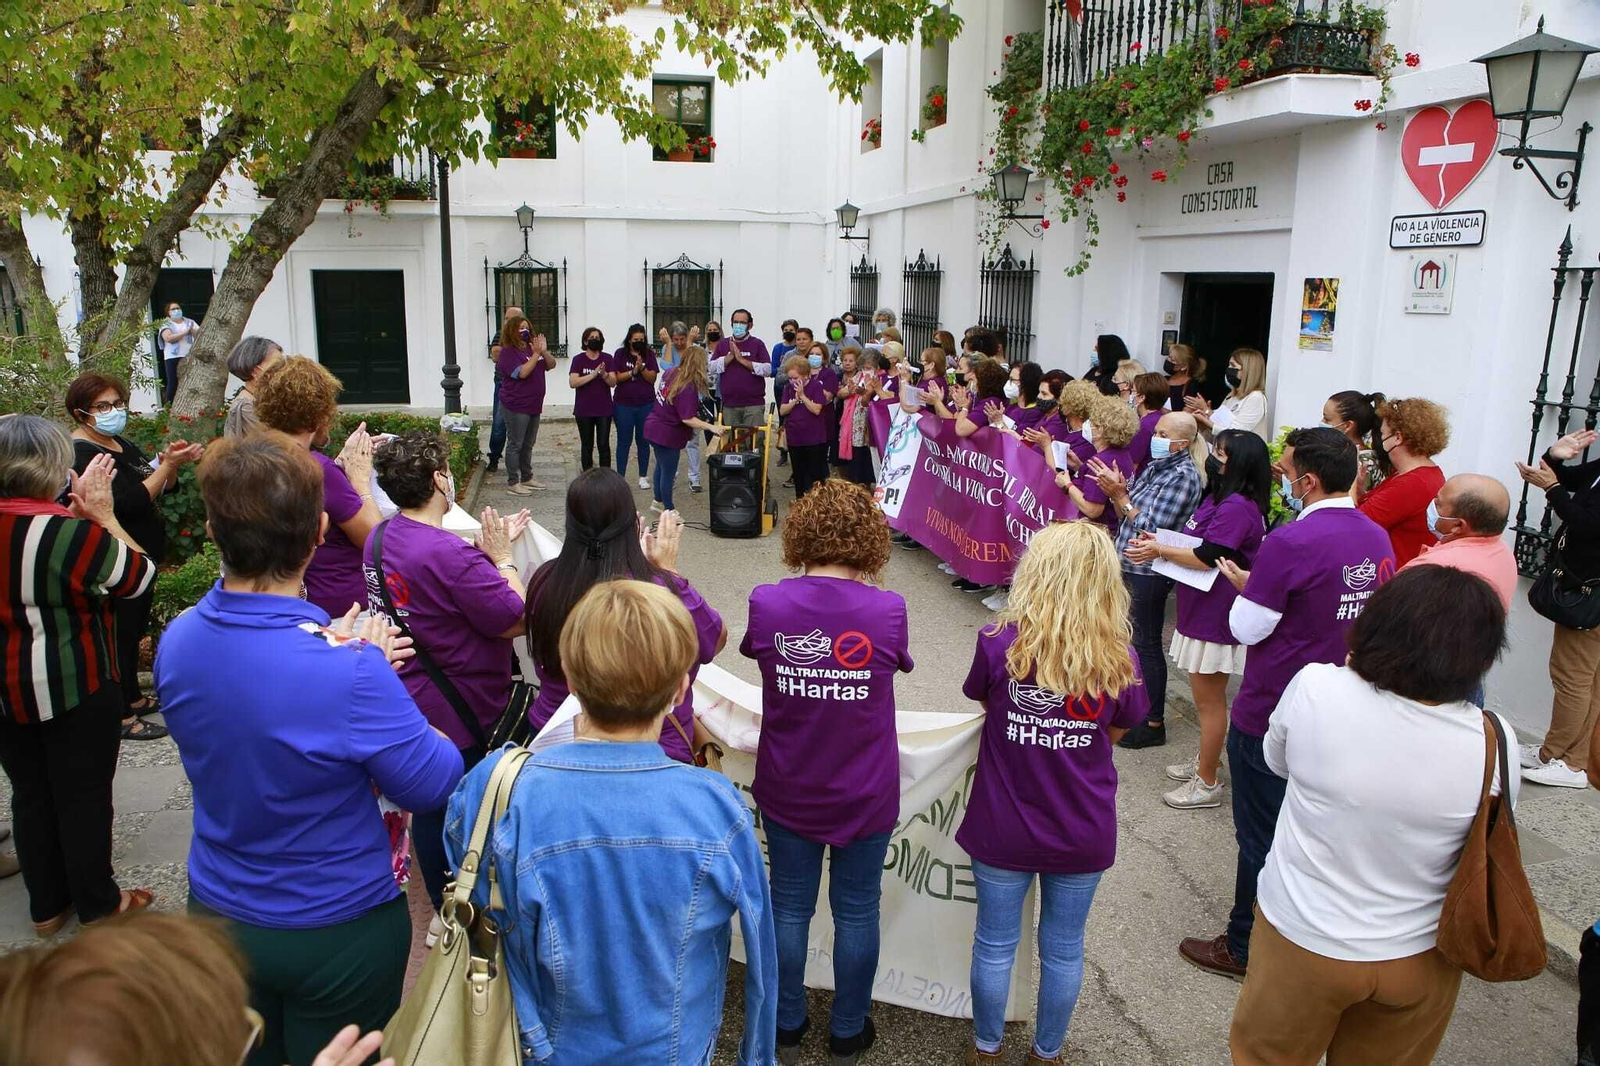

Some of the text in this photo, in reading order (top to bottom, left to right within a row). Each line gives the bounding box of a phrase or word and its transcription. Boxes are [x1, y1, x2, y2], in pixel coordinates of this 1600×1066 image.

[1207, 161, 1233, 185] CASA
[1181, 186, 1258, 214] CONSISTORIAL
[1395, 217, 1480, 232] NO A LA VIOLENCIA
[1409, 233, 1421, 243] DE
[776, 664, 871, 680] MALTRATADORES
[776, 676, 869, 701] #Hartas
[1007, 710, 1098, 730] MALTRATADORES
[1007, 722, 1093, 750] #Hartas
